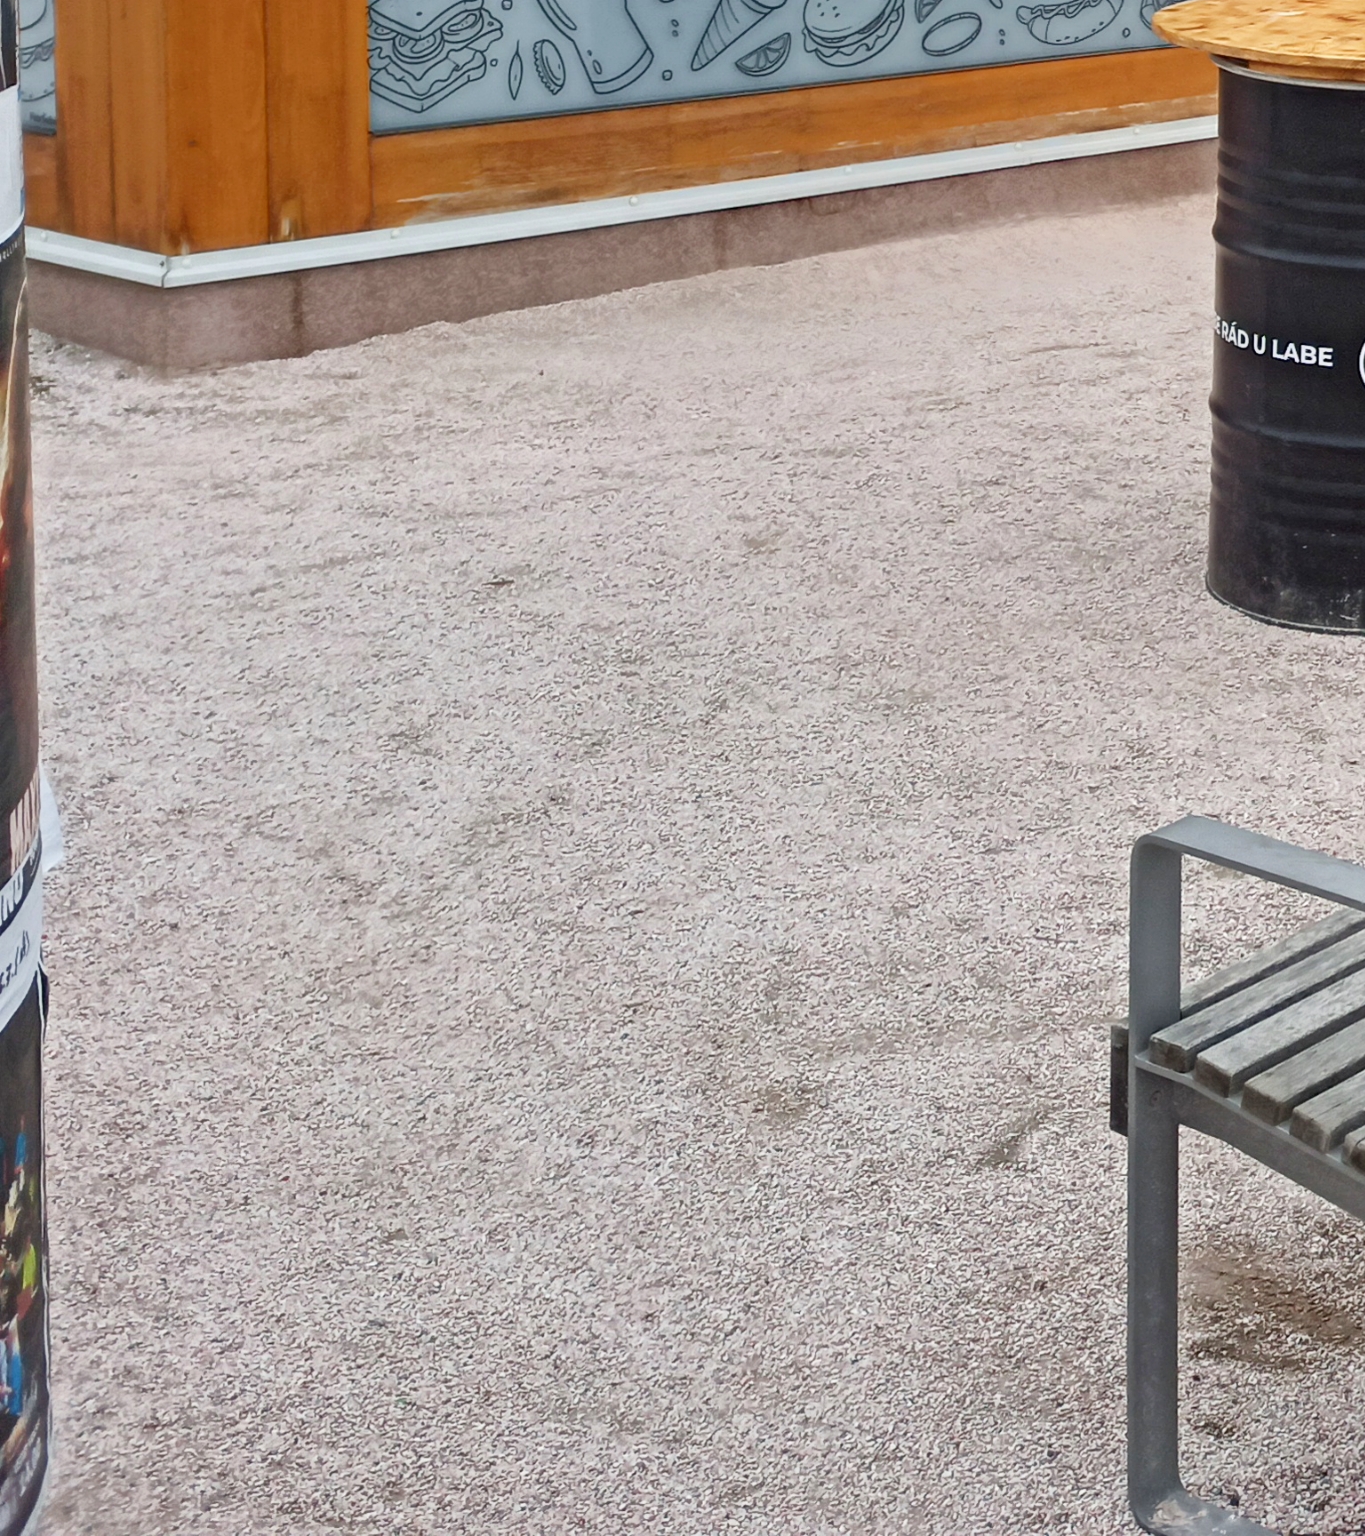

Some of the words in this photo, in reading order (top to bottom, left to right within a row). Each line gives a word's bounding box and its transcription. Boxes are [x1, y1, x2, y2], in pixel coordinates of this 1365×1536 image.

[1221, 320, 1250, 349] RÁD
[1252, 333, 1267, 355] U
[1272, 338, 1334, 367] LABE
